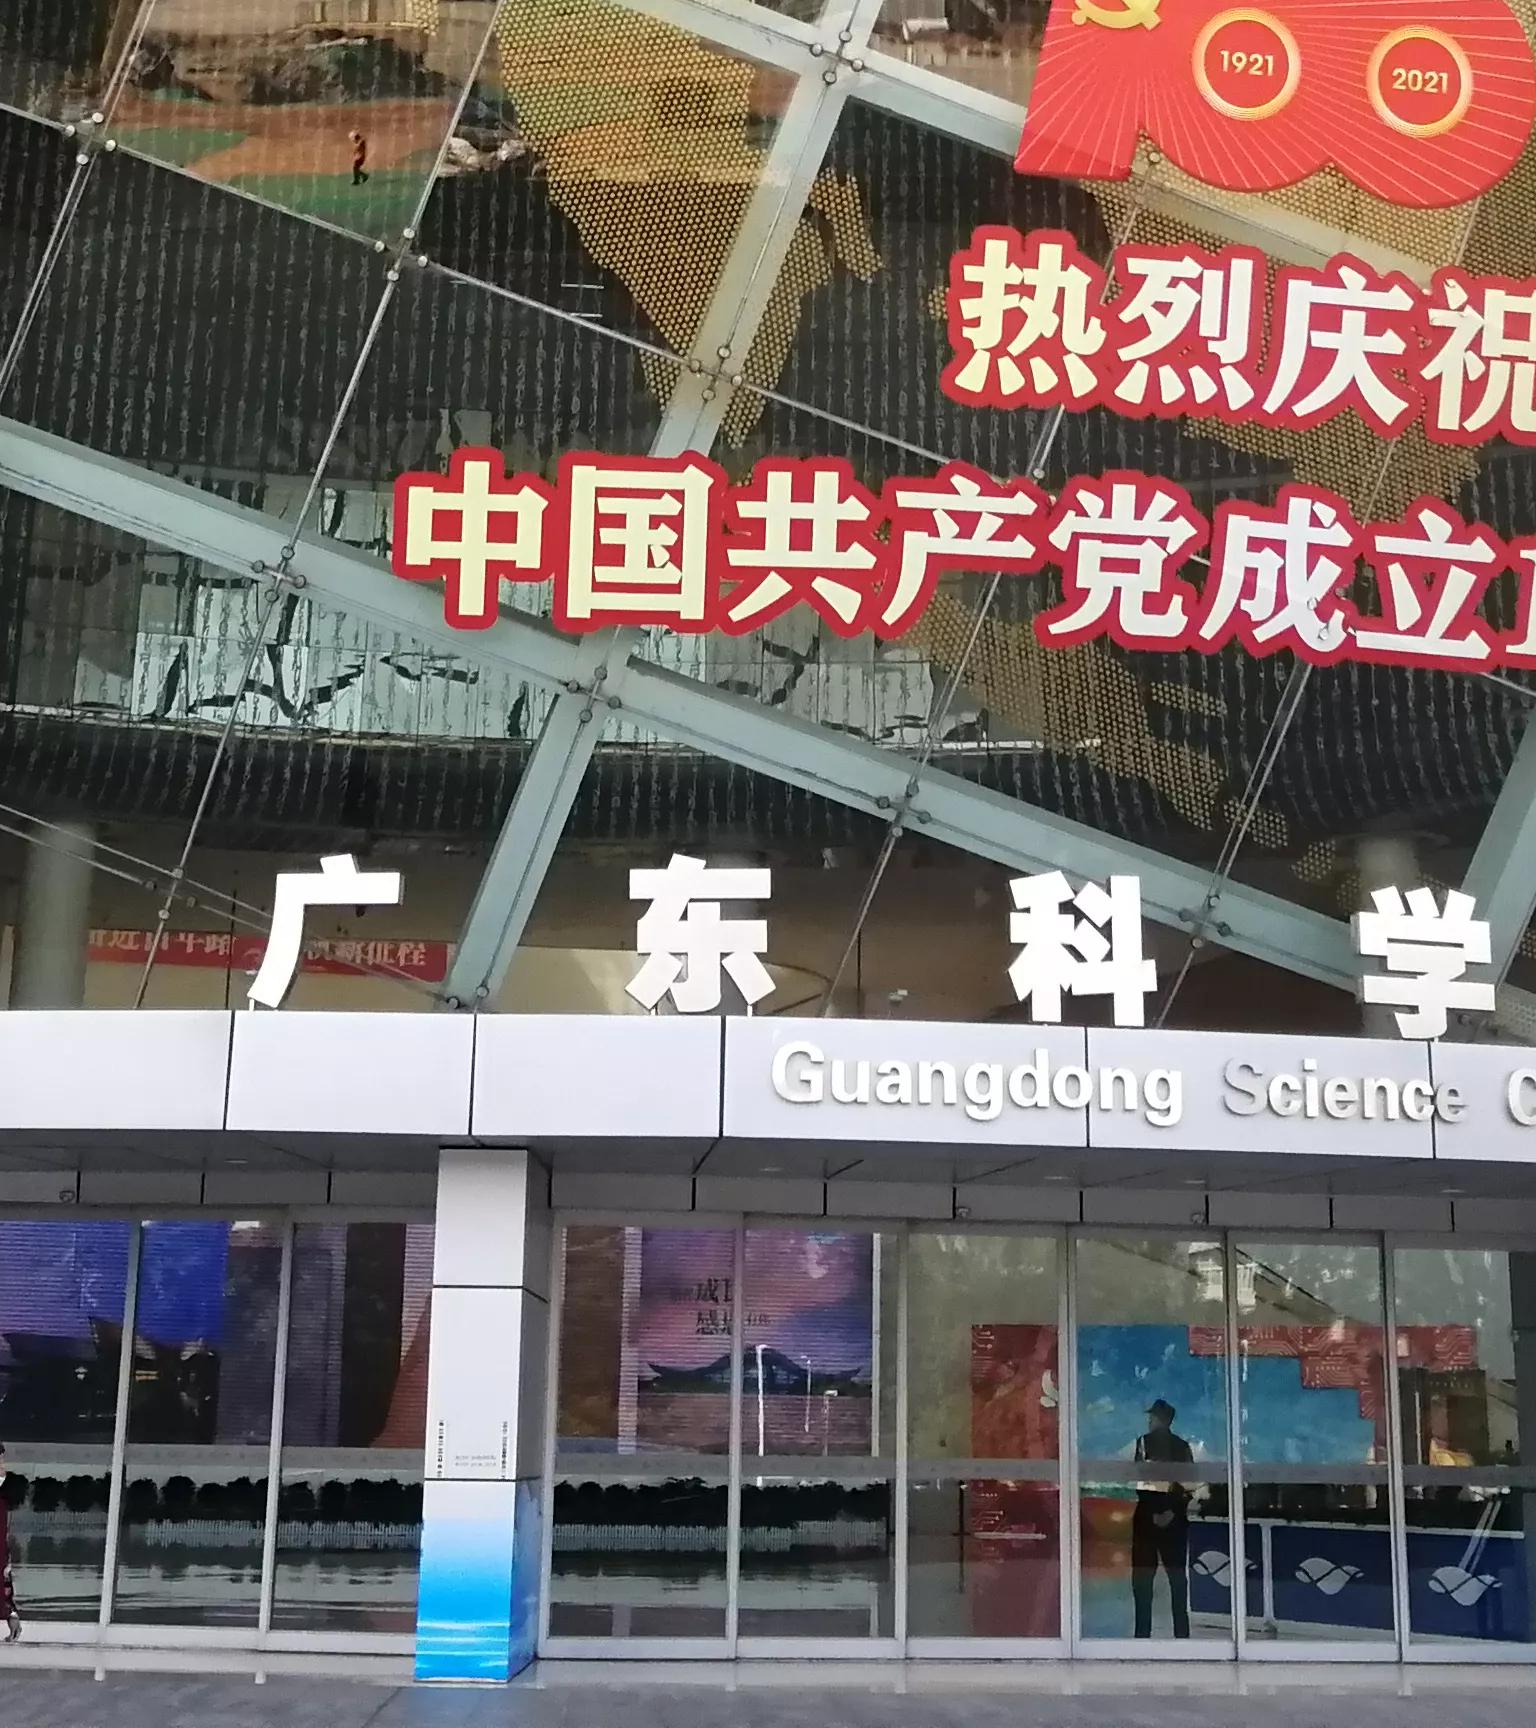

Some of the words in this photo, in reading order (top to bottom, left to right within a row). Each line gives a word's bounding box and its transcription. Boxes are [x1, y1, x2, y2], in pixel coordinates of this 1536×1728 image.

[1220, 50, 1274, 76] 1921
[1391, 68, 1448, 94] 2021
[770, 1041, 1184, 1127] Guangdong
[1222, 1056, 1467, 1125] Science
